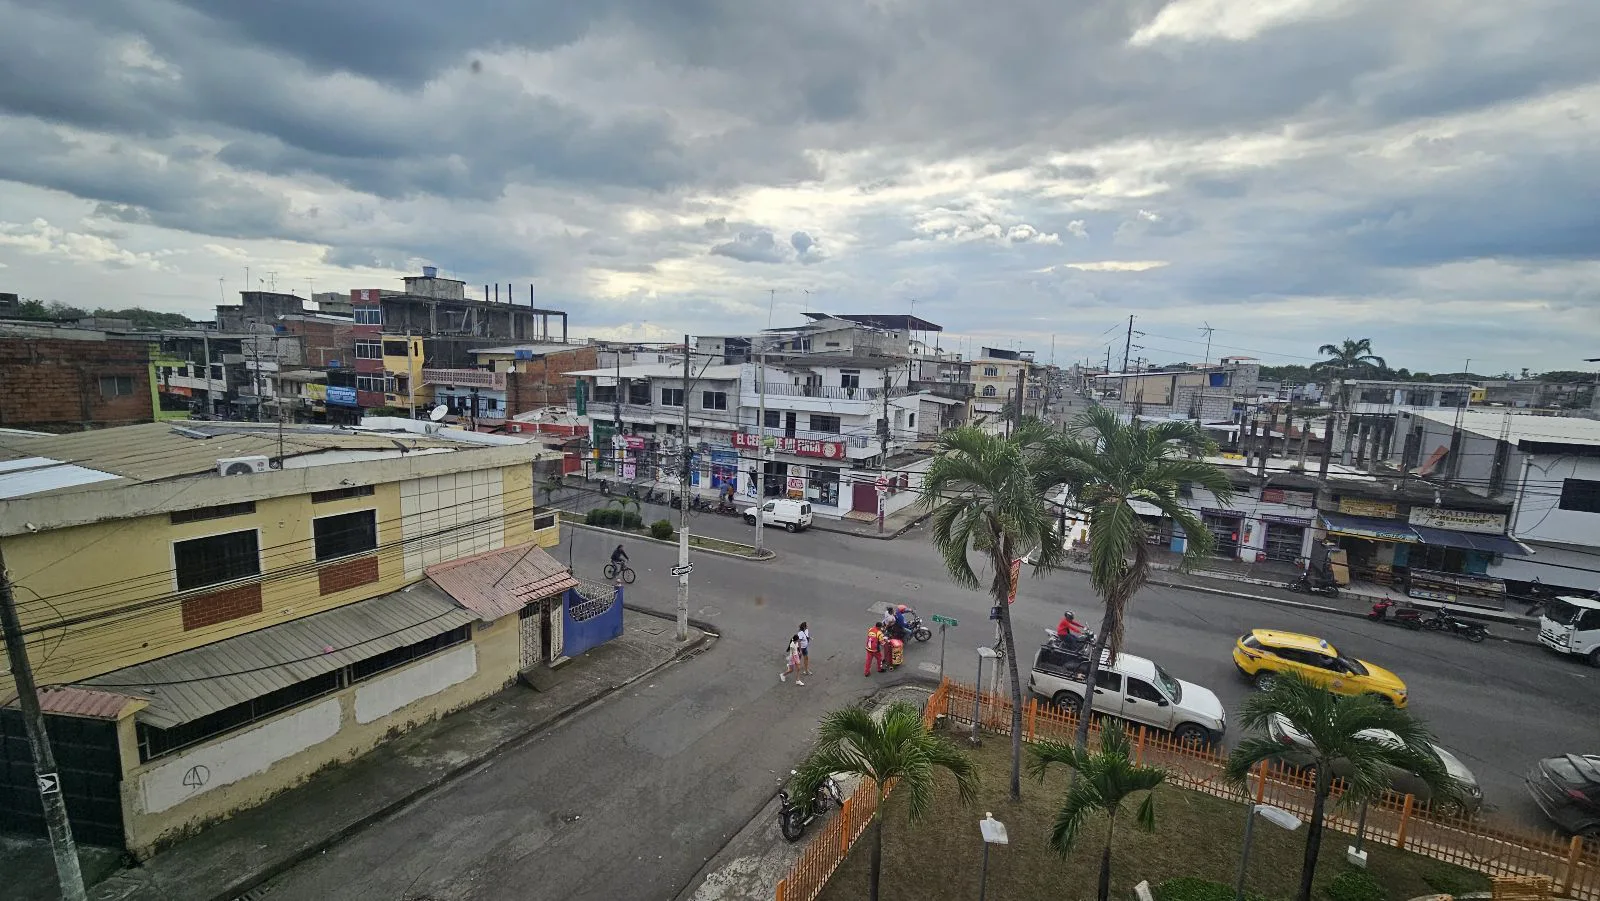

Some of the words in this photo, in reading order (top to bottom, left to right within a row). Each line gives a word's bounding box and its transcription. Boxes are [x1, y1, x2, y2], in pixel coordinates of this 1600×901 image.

[736, 433, 745, 445] EL
[785, 438, 796, 450] MI
[797, 440, 821, 453] FINCA
